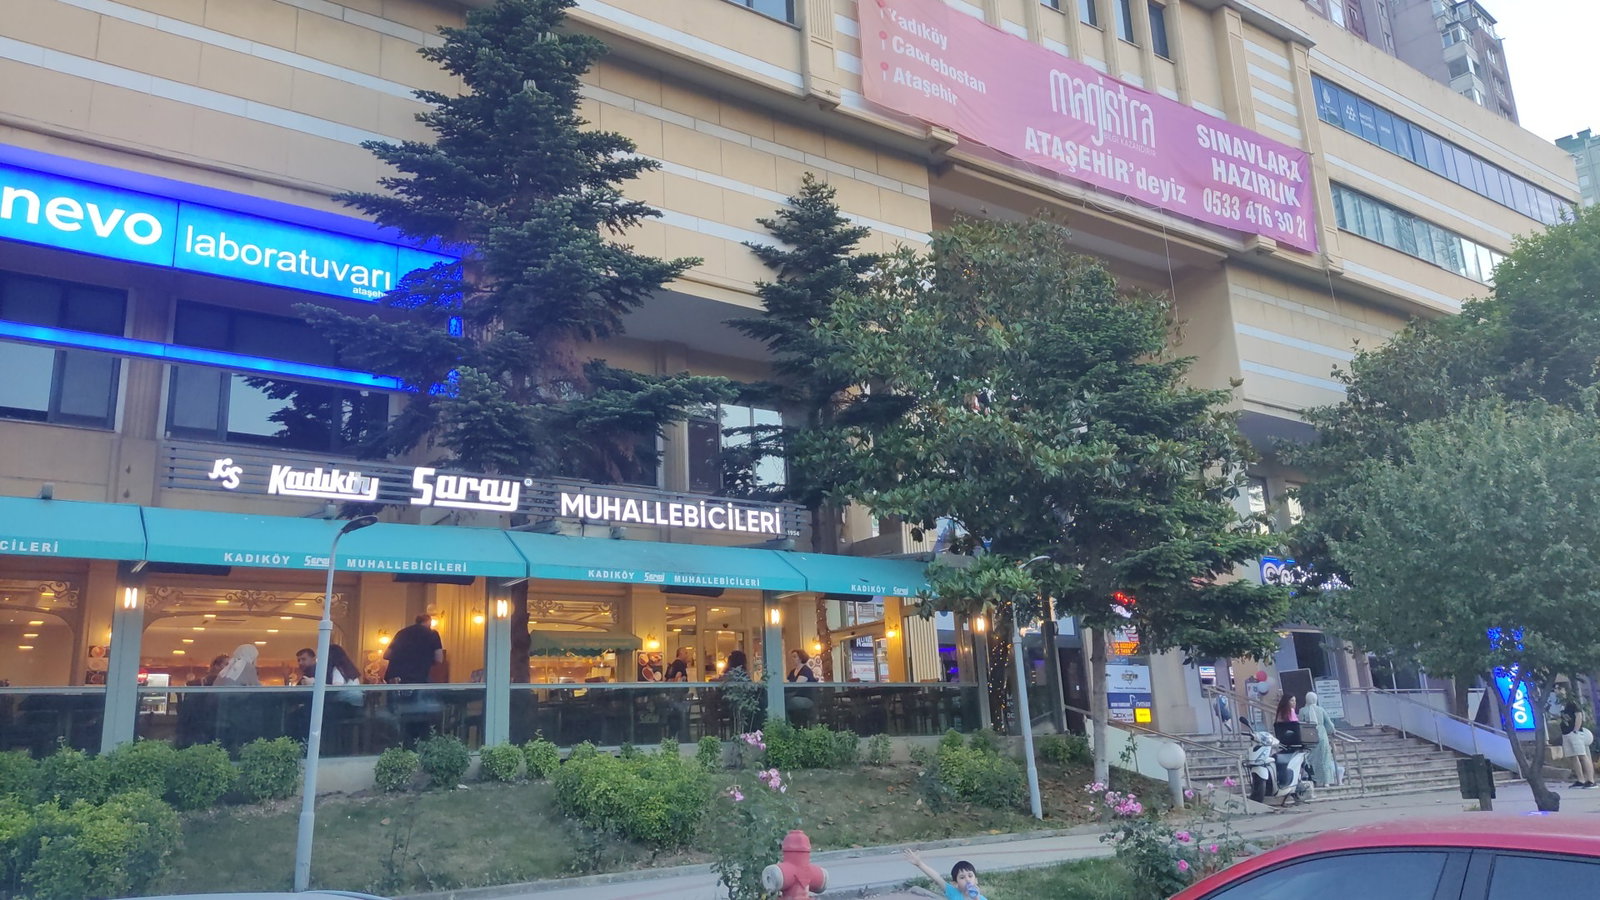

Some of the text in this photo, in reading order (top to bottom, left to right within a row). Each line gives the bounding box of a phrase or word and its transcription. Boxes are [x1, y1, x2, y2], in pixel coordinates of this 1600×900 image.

[893, 67, 958, 105] Ataşehir
[1196, 123, 1303, 183] SINAVLARA
[1211, 157, 1301, 208] HAZIRLIK
[1203, 188, 1307, 241] 0533 476 30 21
[1, 186, 391, 290] nevo laboratuvarı
[352, 287, 388, 299] ataşeh
[267, 464, 379, 501] Kadıköy
[410, 466, 520, 512] Saray
[560, 492, 782, 534] MUHALLEBİCİLERİ
[224, 551, 290, 565] KADIKÖY
[346, 558, 467, 572] MUHALLEBİCİLERİ
[588, 569, 635, 580] KADIKÖY
[674, 575, 760, 586] MUHALLEBİCİLERİ
[851, 584, 886, 593] KADIKÖY
[1512, 689, 1528, 724] evo
